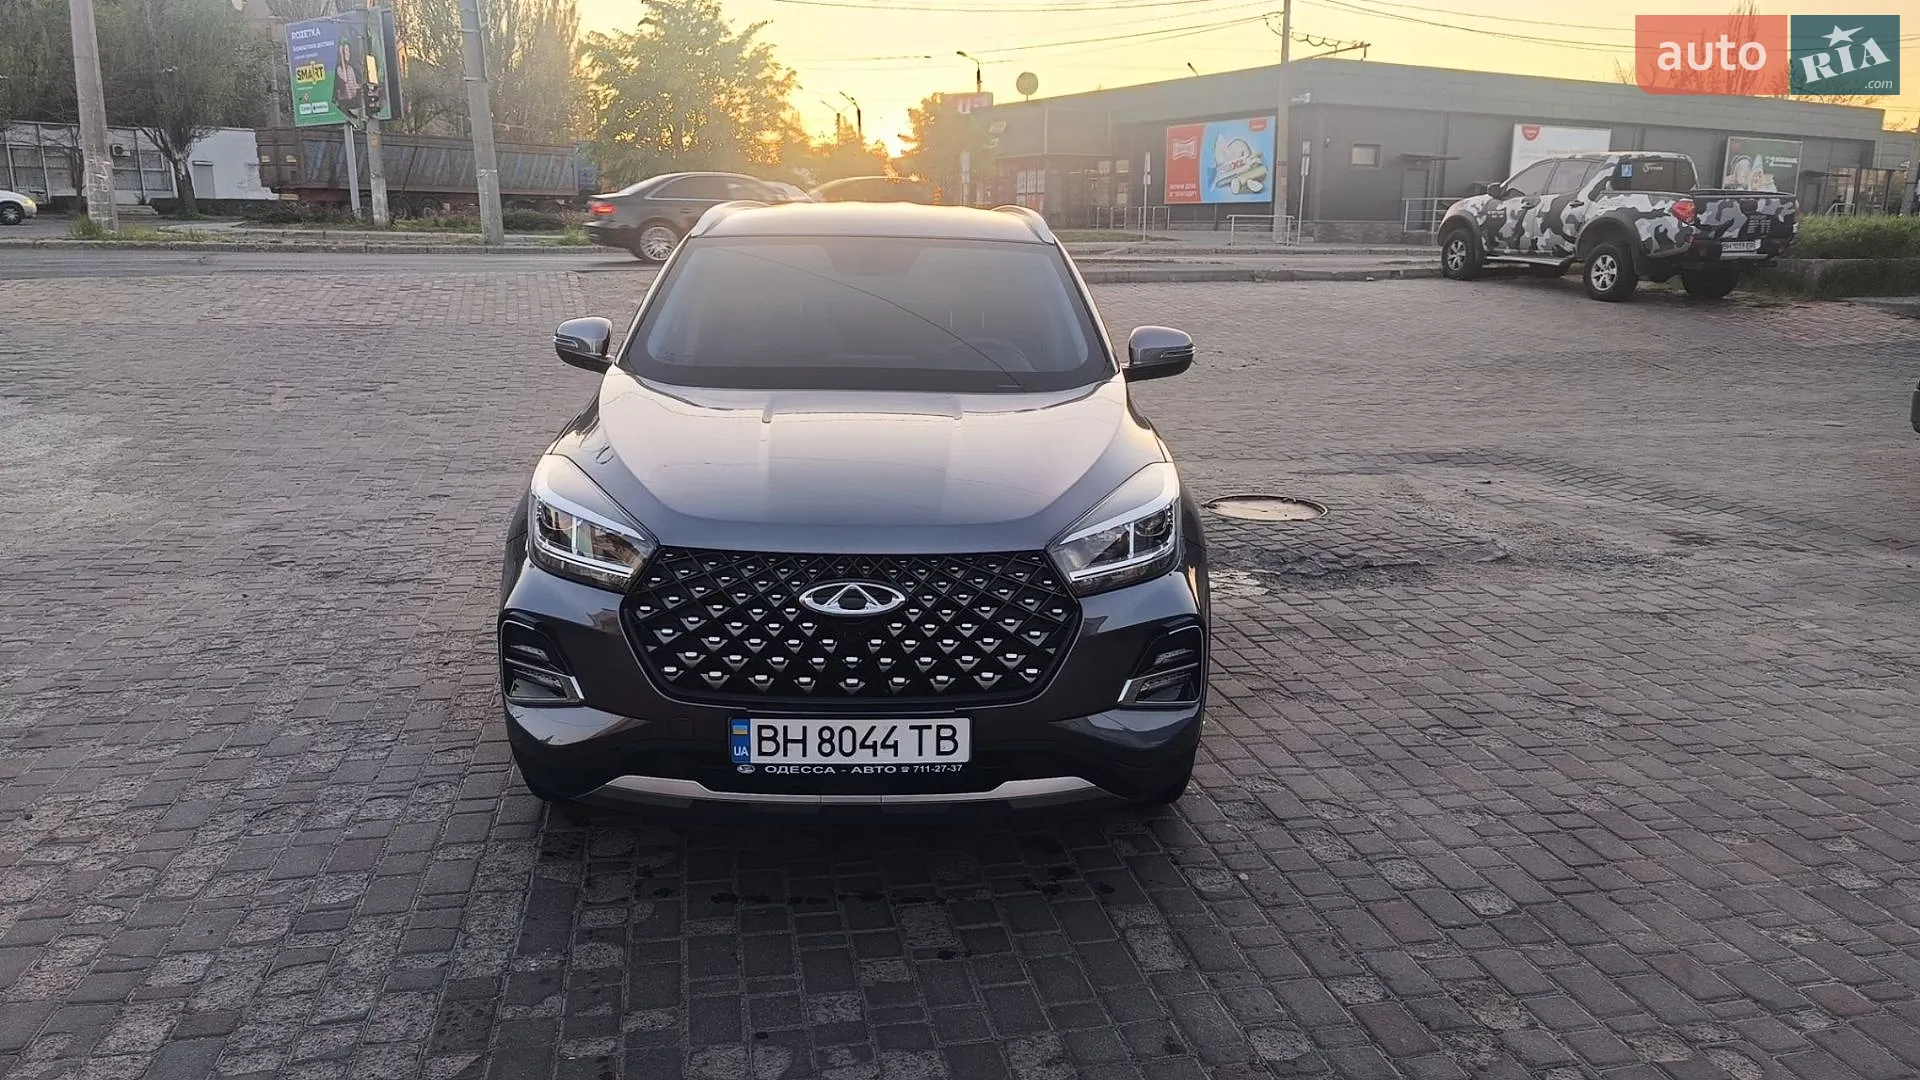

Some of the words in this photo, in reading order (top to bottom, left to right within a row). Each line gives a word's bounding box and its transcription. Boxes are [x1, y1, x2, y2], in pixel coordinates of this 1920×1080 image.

[291, 27, 321, 40] ROZETKA
[296, 65, 324, 81] SMART
[757, 724, 808, 758] BH
[817, 724, 899, 758] 8044
[909, 724, 959, 757] TB
[733, 745, 749, 756] UA
[764, 765, 836, 775] ОДЕССА
[850, 765, 897, 774] АВТО
[913, 764, 963, 774] 711-27-37
